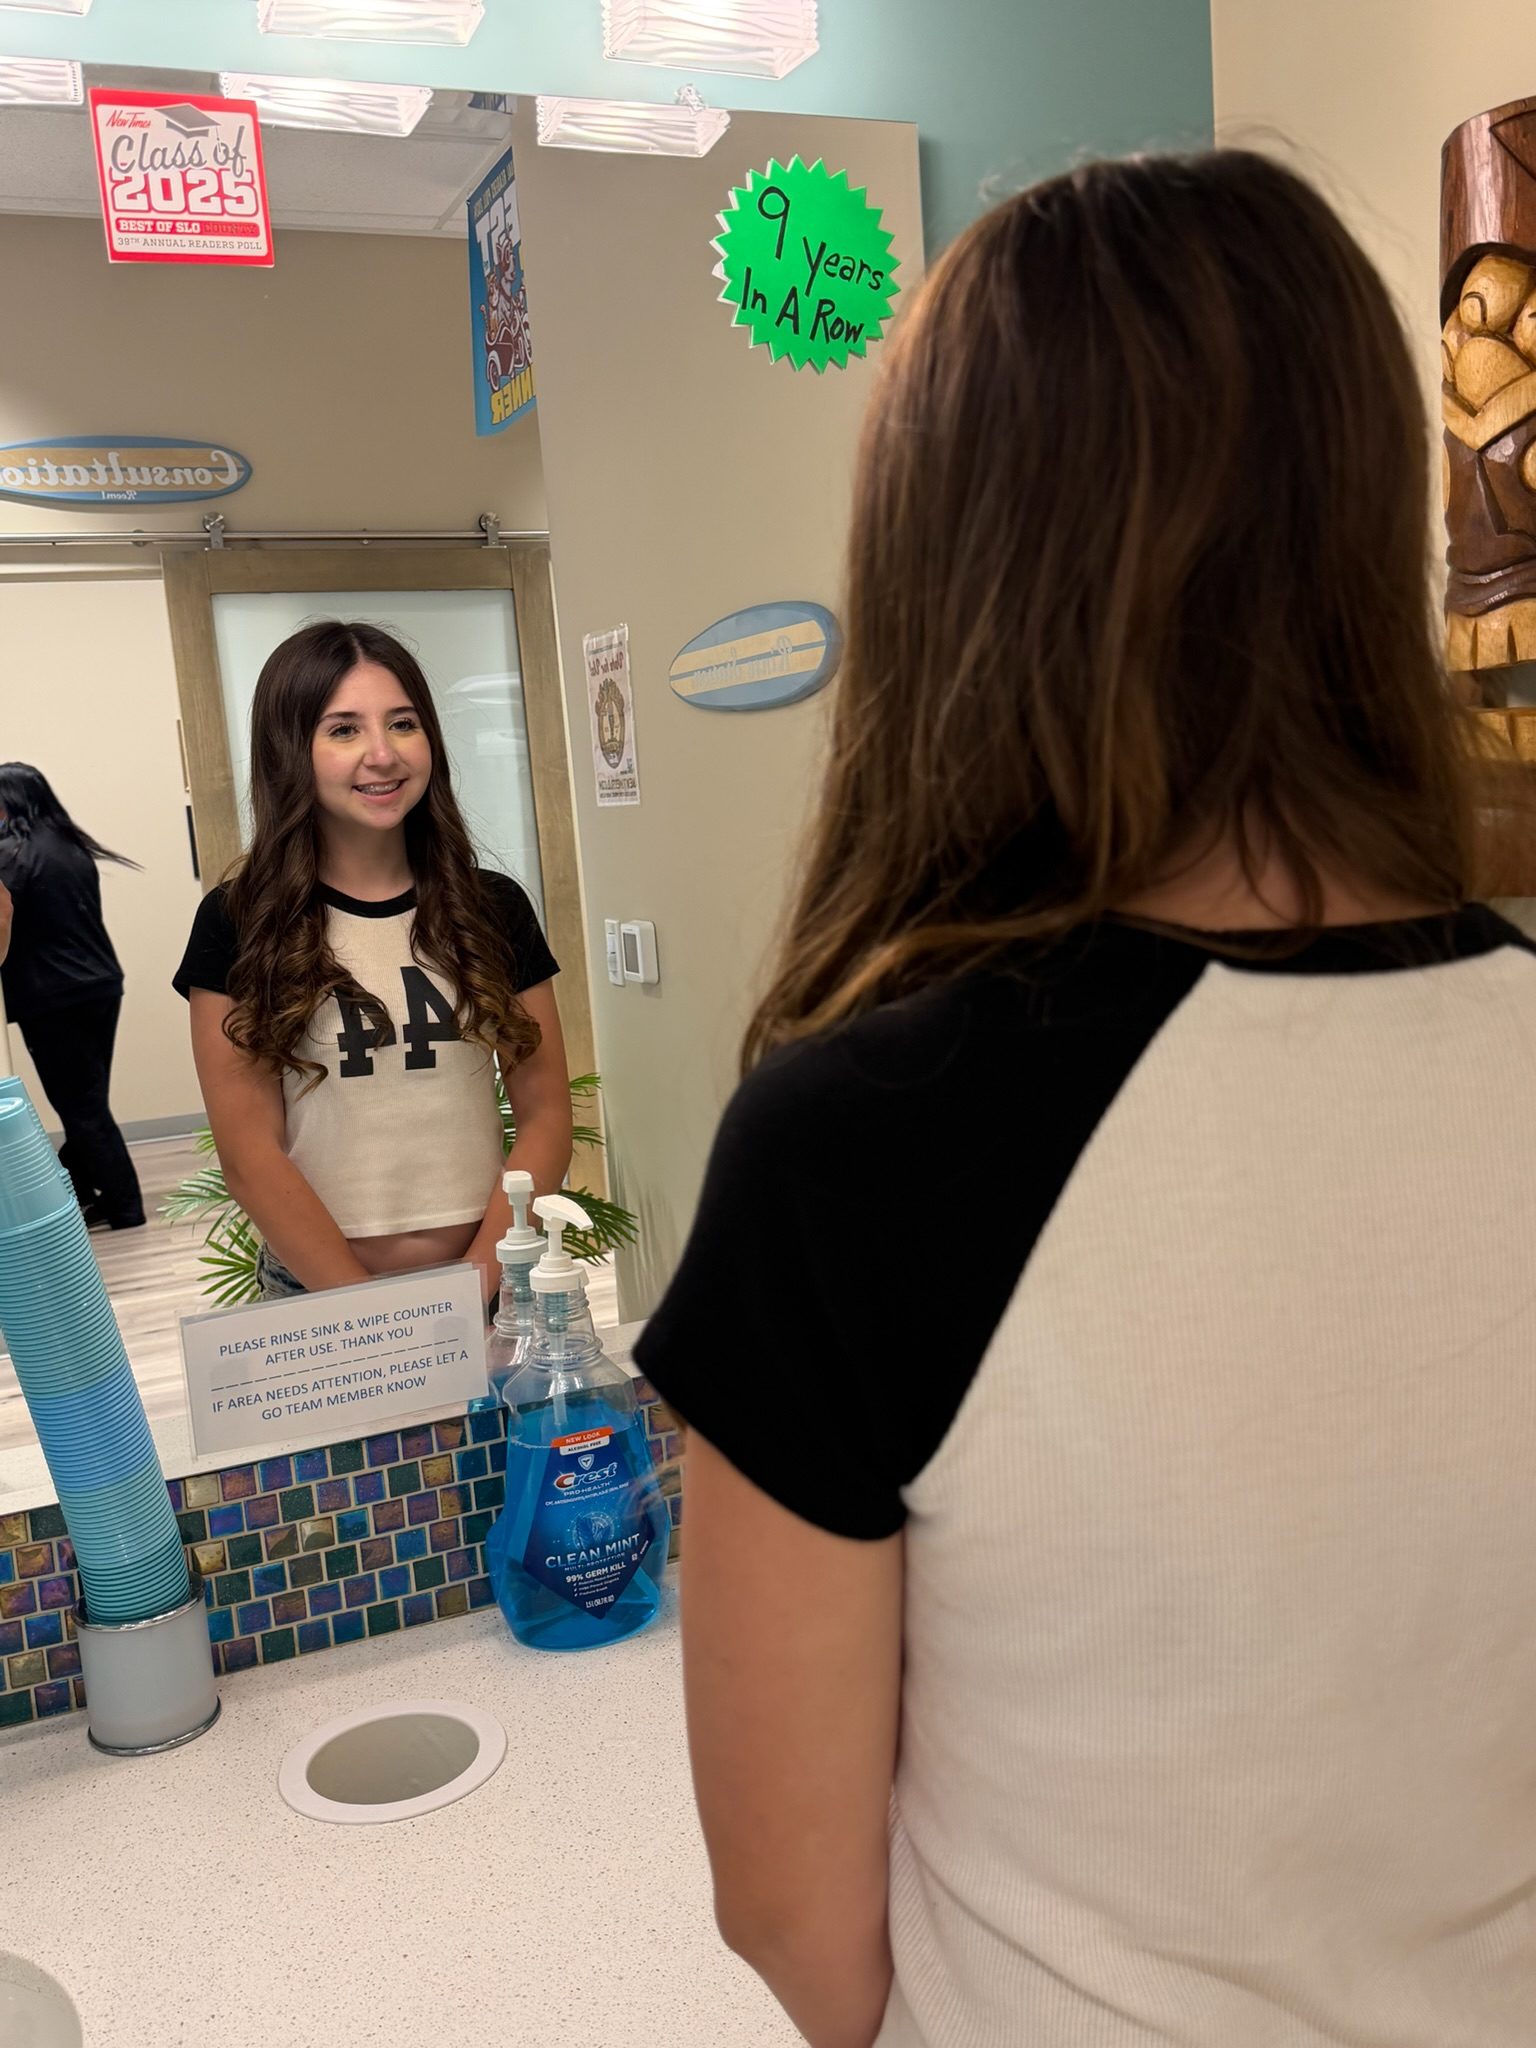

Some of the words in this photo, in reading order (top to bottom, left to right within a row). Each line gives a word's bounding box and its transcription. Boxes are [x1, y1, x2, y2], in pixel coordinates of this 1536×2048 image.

[111, 132, 207, 174] Class
[213, 125, 247, 178] of
[109, 168, 259, 217] 2025
[119, 219, 154, 232] BEST
[156, 221, 173, 233] OF
[175, 221, 201, 234] SLO
[142, 238, 186, 248] ANNUAL
[188, 240, 235, 250] READERS
[237, 241, 263, 251] POLL
[757, 186, 790, 261] 9
[741, 266, 767, 314] In
[775, 285, 799, 335] A
[809, 299, 865, 344] Row
[219, 1337, 267, 1357] PLEASE
[270, 1329, 308, 1346] RINSE
[311, 1322, 341, 1338] SINK
[344, 1320, 354, 1332] &
[357, 1313, 390, 1329] WIPE
[393, 1301, 453, 1322] COUNTER
[265, 1347, 306, 1366] AFTER
[309, 1342, 338, 1356] USE.
[340, 1332, 385, 1350] THANK
[387, 1326, 414, 1340] YOU
[212, 1401, 225, 1413] IF
[227, 1393, 263, 1410] AREA
[266, 1383, 309, 1401] NEEDS
[311, 1367, 386, 1392] ATTENTION,
[389, 1357, 433, 1375] PLEASE
[436, 1352, 457, 1365] LET
[459, 1350, 469, 1361] A
[261, 1407, 283, 1420] GO
[285, 1398, 323, 1415] TEAM
[326, 1385, 384, 1407] MEMBER
[387, 1375, 427, 1394] KNOW
[565, 1435, 582, 1444] NEW
[583, 1431, 601, 1440] LOOK
[554, 1462, 619, 1490] Crest
[545, 1547, 601, 1569] CLEAN
[605, 1533, 640, 1555] MINT
[565, 1574, 584, 1583] 99%
[585, 1566, 609, 1579] GERM
[609, 1561, 627, 1572] KILL
